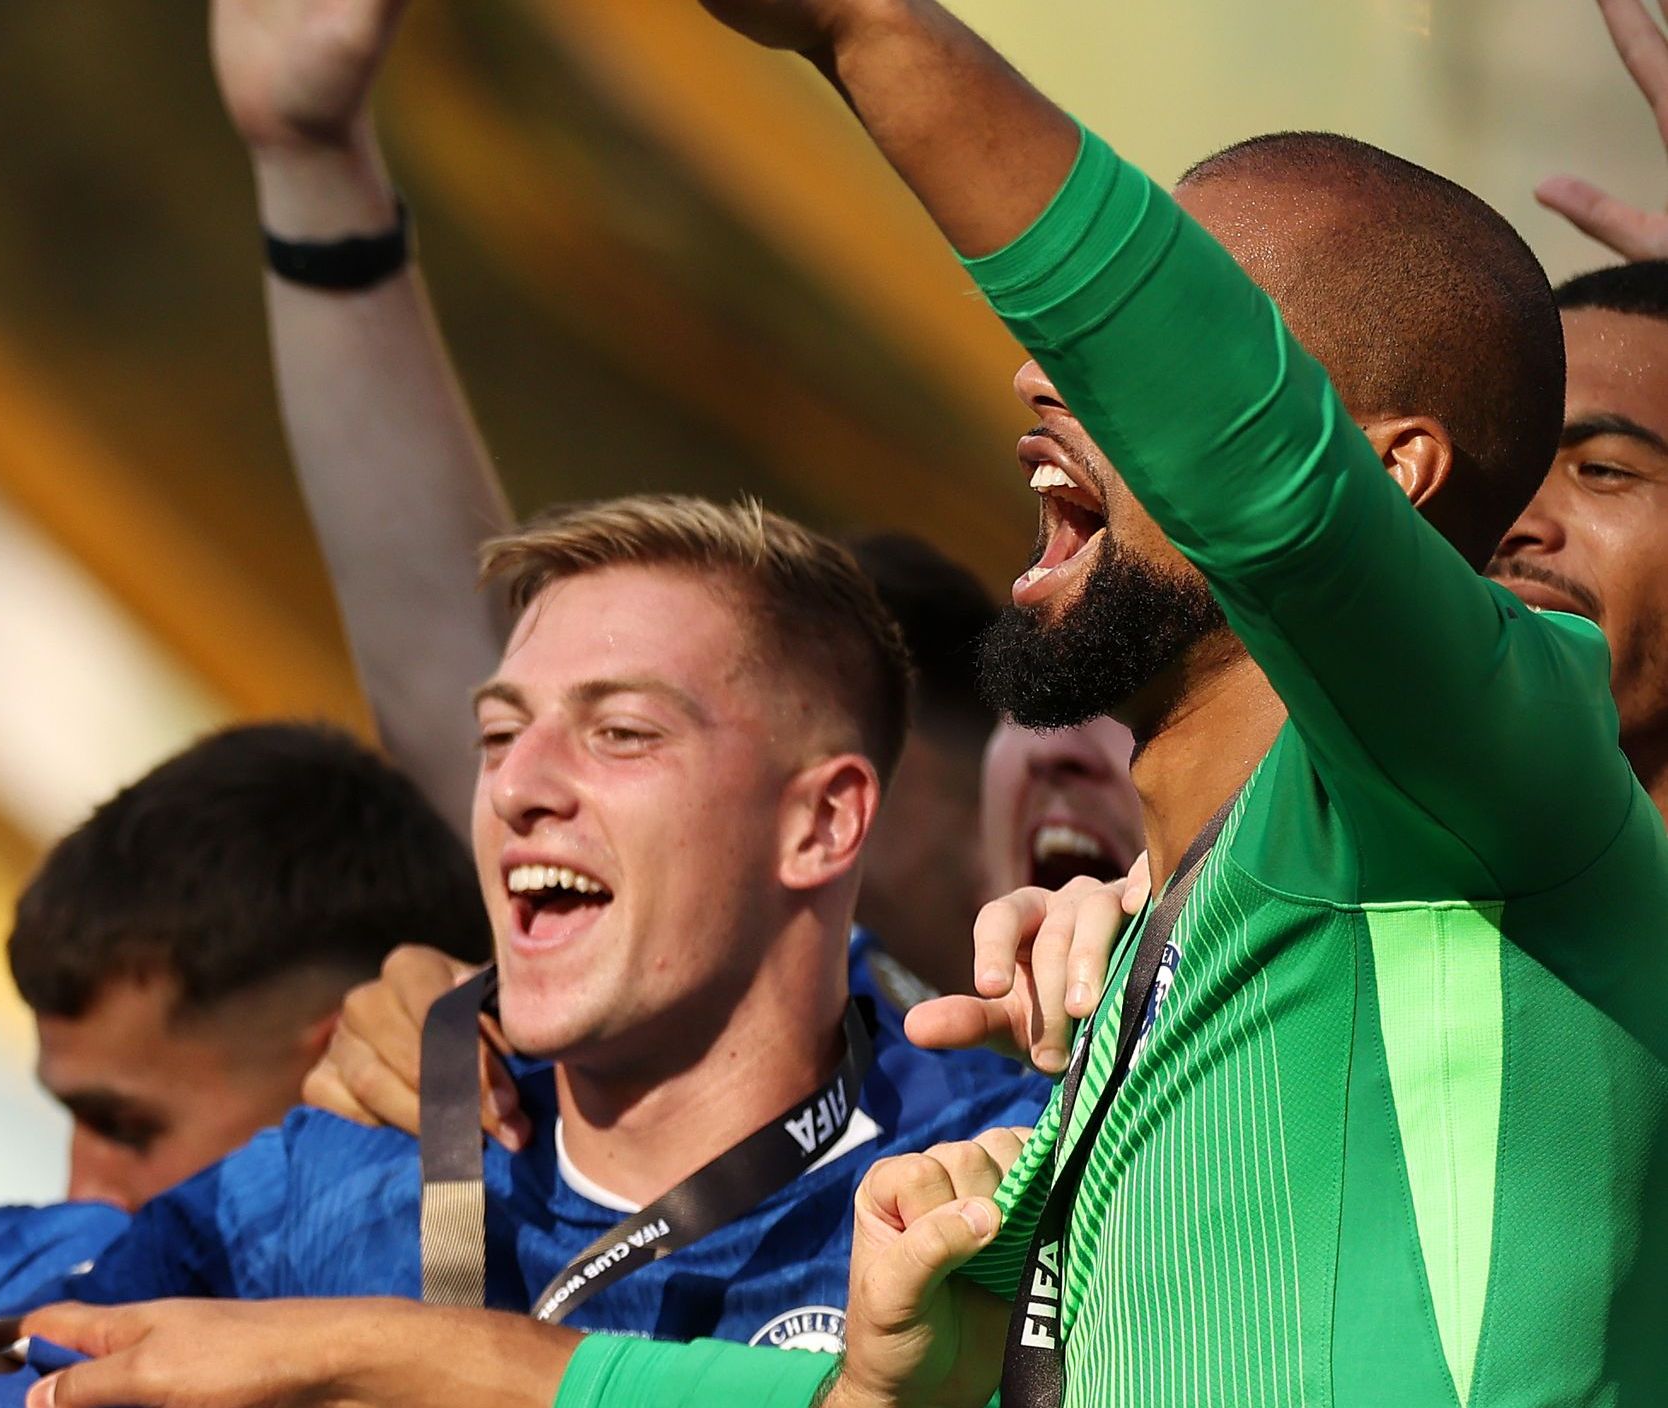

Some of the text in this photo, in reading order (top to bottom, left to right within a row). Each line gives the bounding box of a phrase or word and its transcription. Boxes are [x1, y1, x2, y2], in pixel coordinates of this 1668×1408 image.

[627, 1217, 671, 1248] FIFA
[583, 1243, 630, 1279] CLUB
[1020, 1240, 1059, 1350] FIFA
[768, 1314, 846, 1345] CHELS
